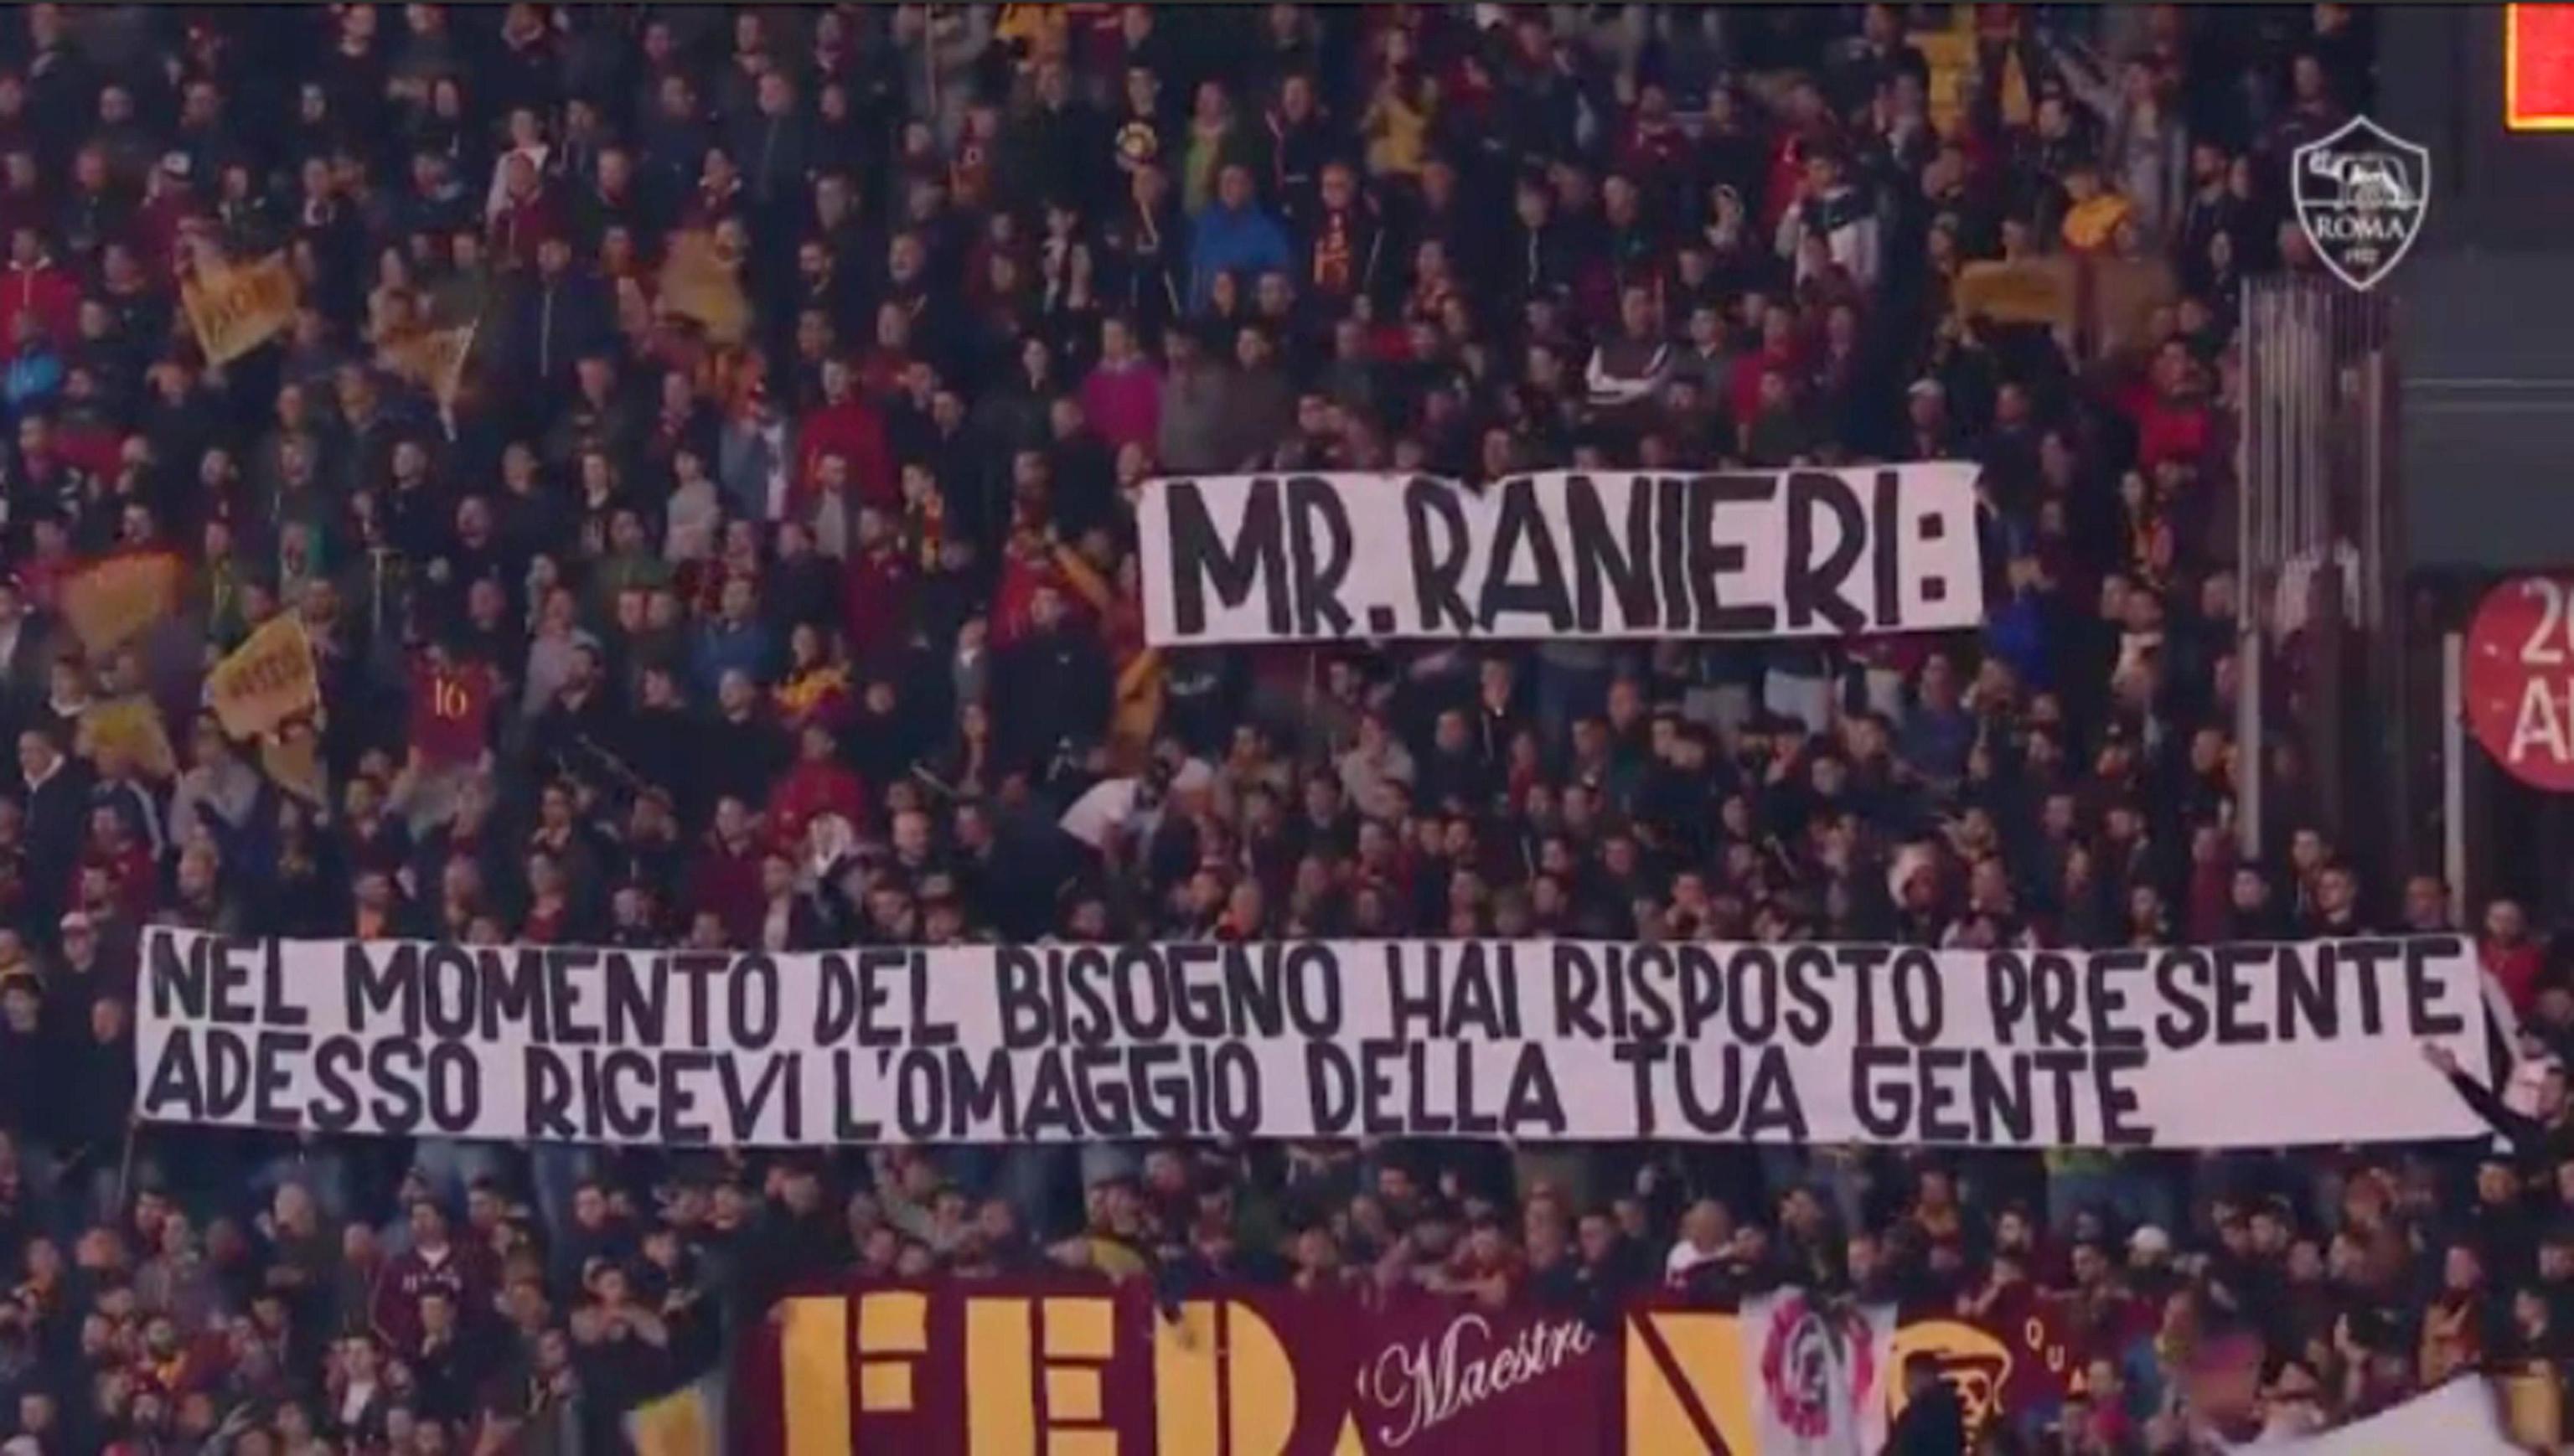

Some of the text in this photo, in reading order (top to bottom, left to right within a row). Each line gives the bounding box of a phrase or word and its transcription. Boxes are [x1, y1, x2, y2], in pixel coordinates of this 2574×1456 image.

[435, 677, 467, 719] 16
[2508, 676, 2574, 762] A
[146, 932, 2464, 1051] NEL MOMENTO DEL BISOGNO HAI RISPOSTO PRESENTE
[144, 1026, 2153, 1145] ADESSO RICEVI L'OMAGGIO DELLA TUA GENTE
